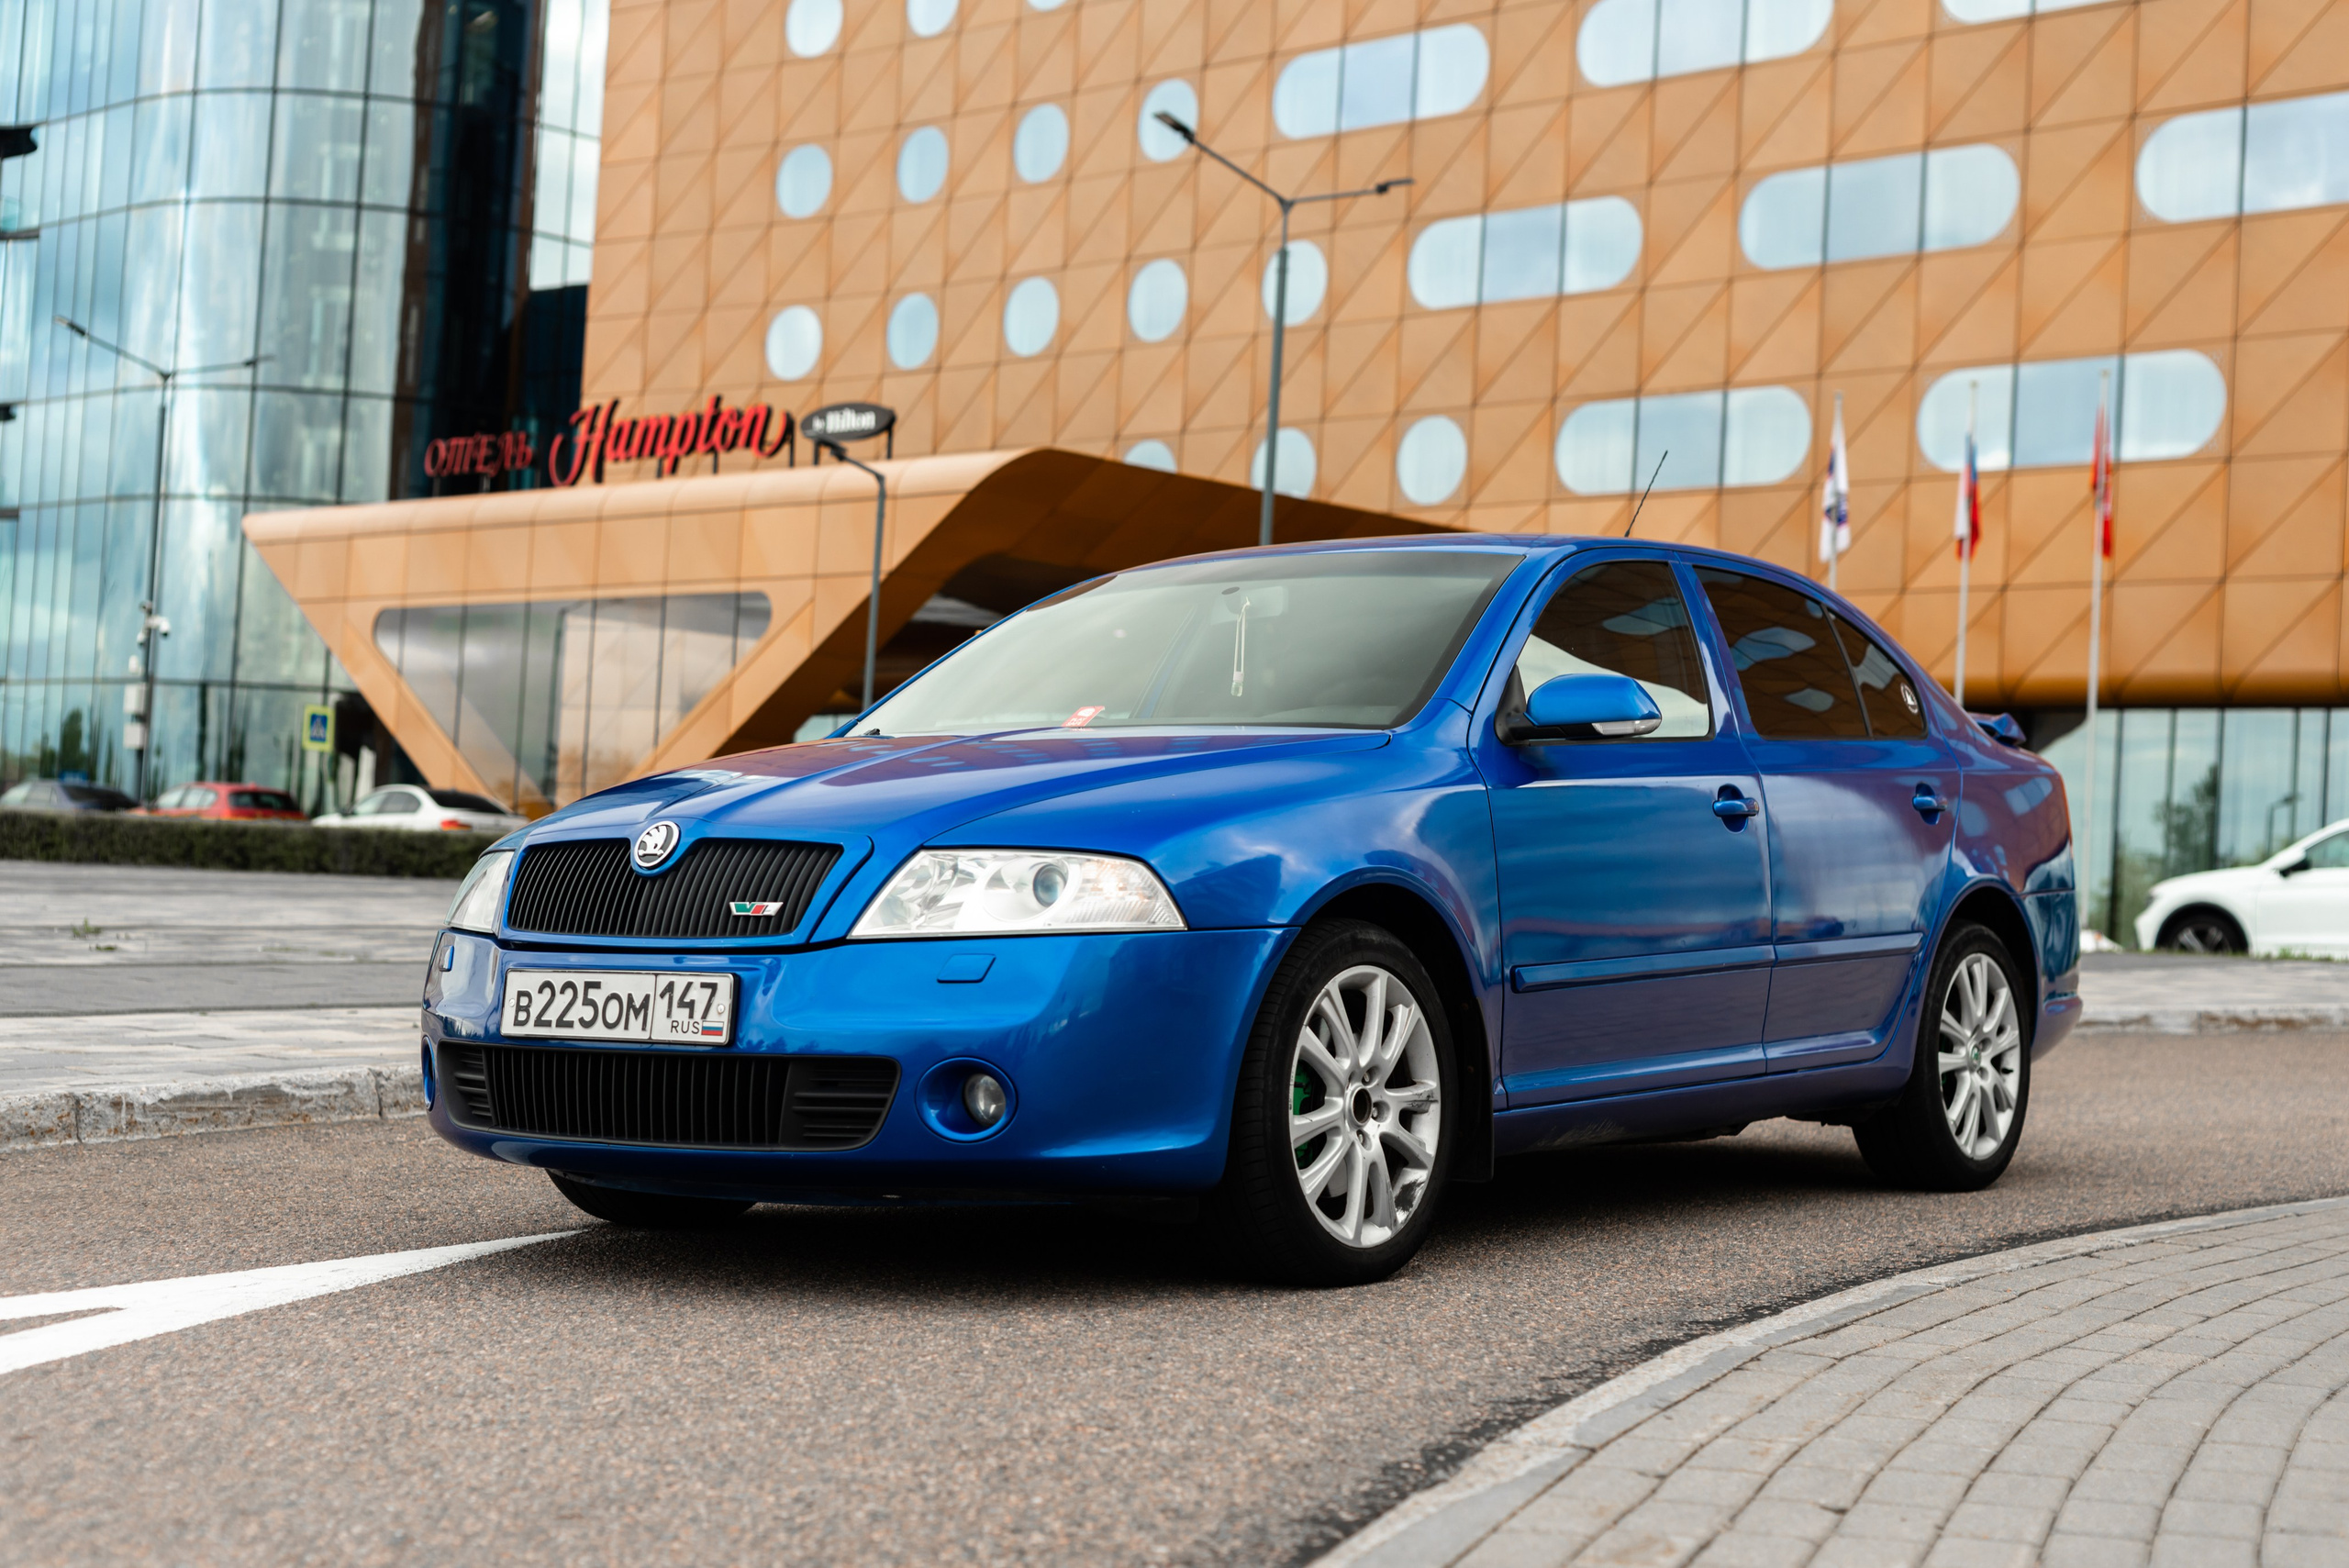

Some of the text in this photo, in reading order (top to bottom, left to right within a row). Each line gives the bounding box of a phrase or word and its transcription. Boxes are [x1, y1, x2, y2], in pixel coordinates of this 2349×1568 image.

[827, 407, 875, 434] Hilton
[549, 395, 791, 486] Hampton
[659, 981, 718, 1020] 147
[671, 1020, 700, 1034] RUS
